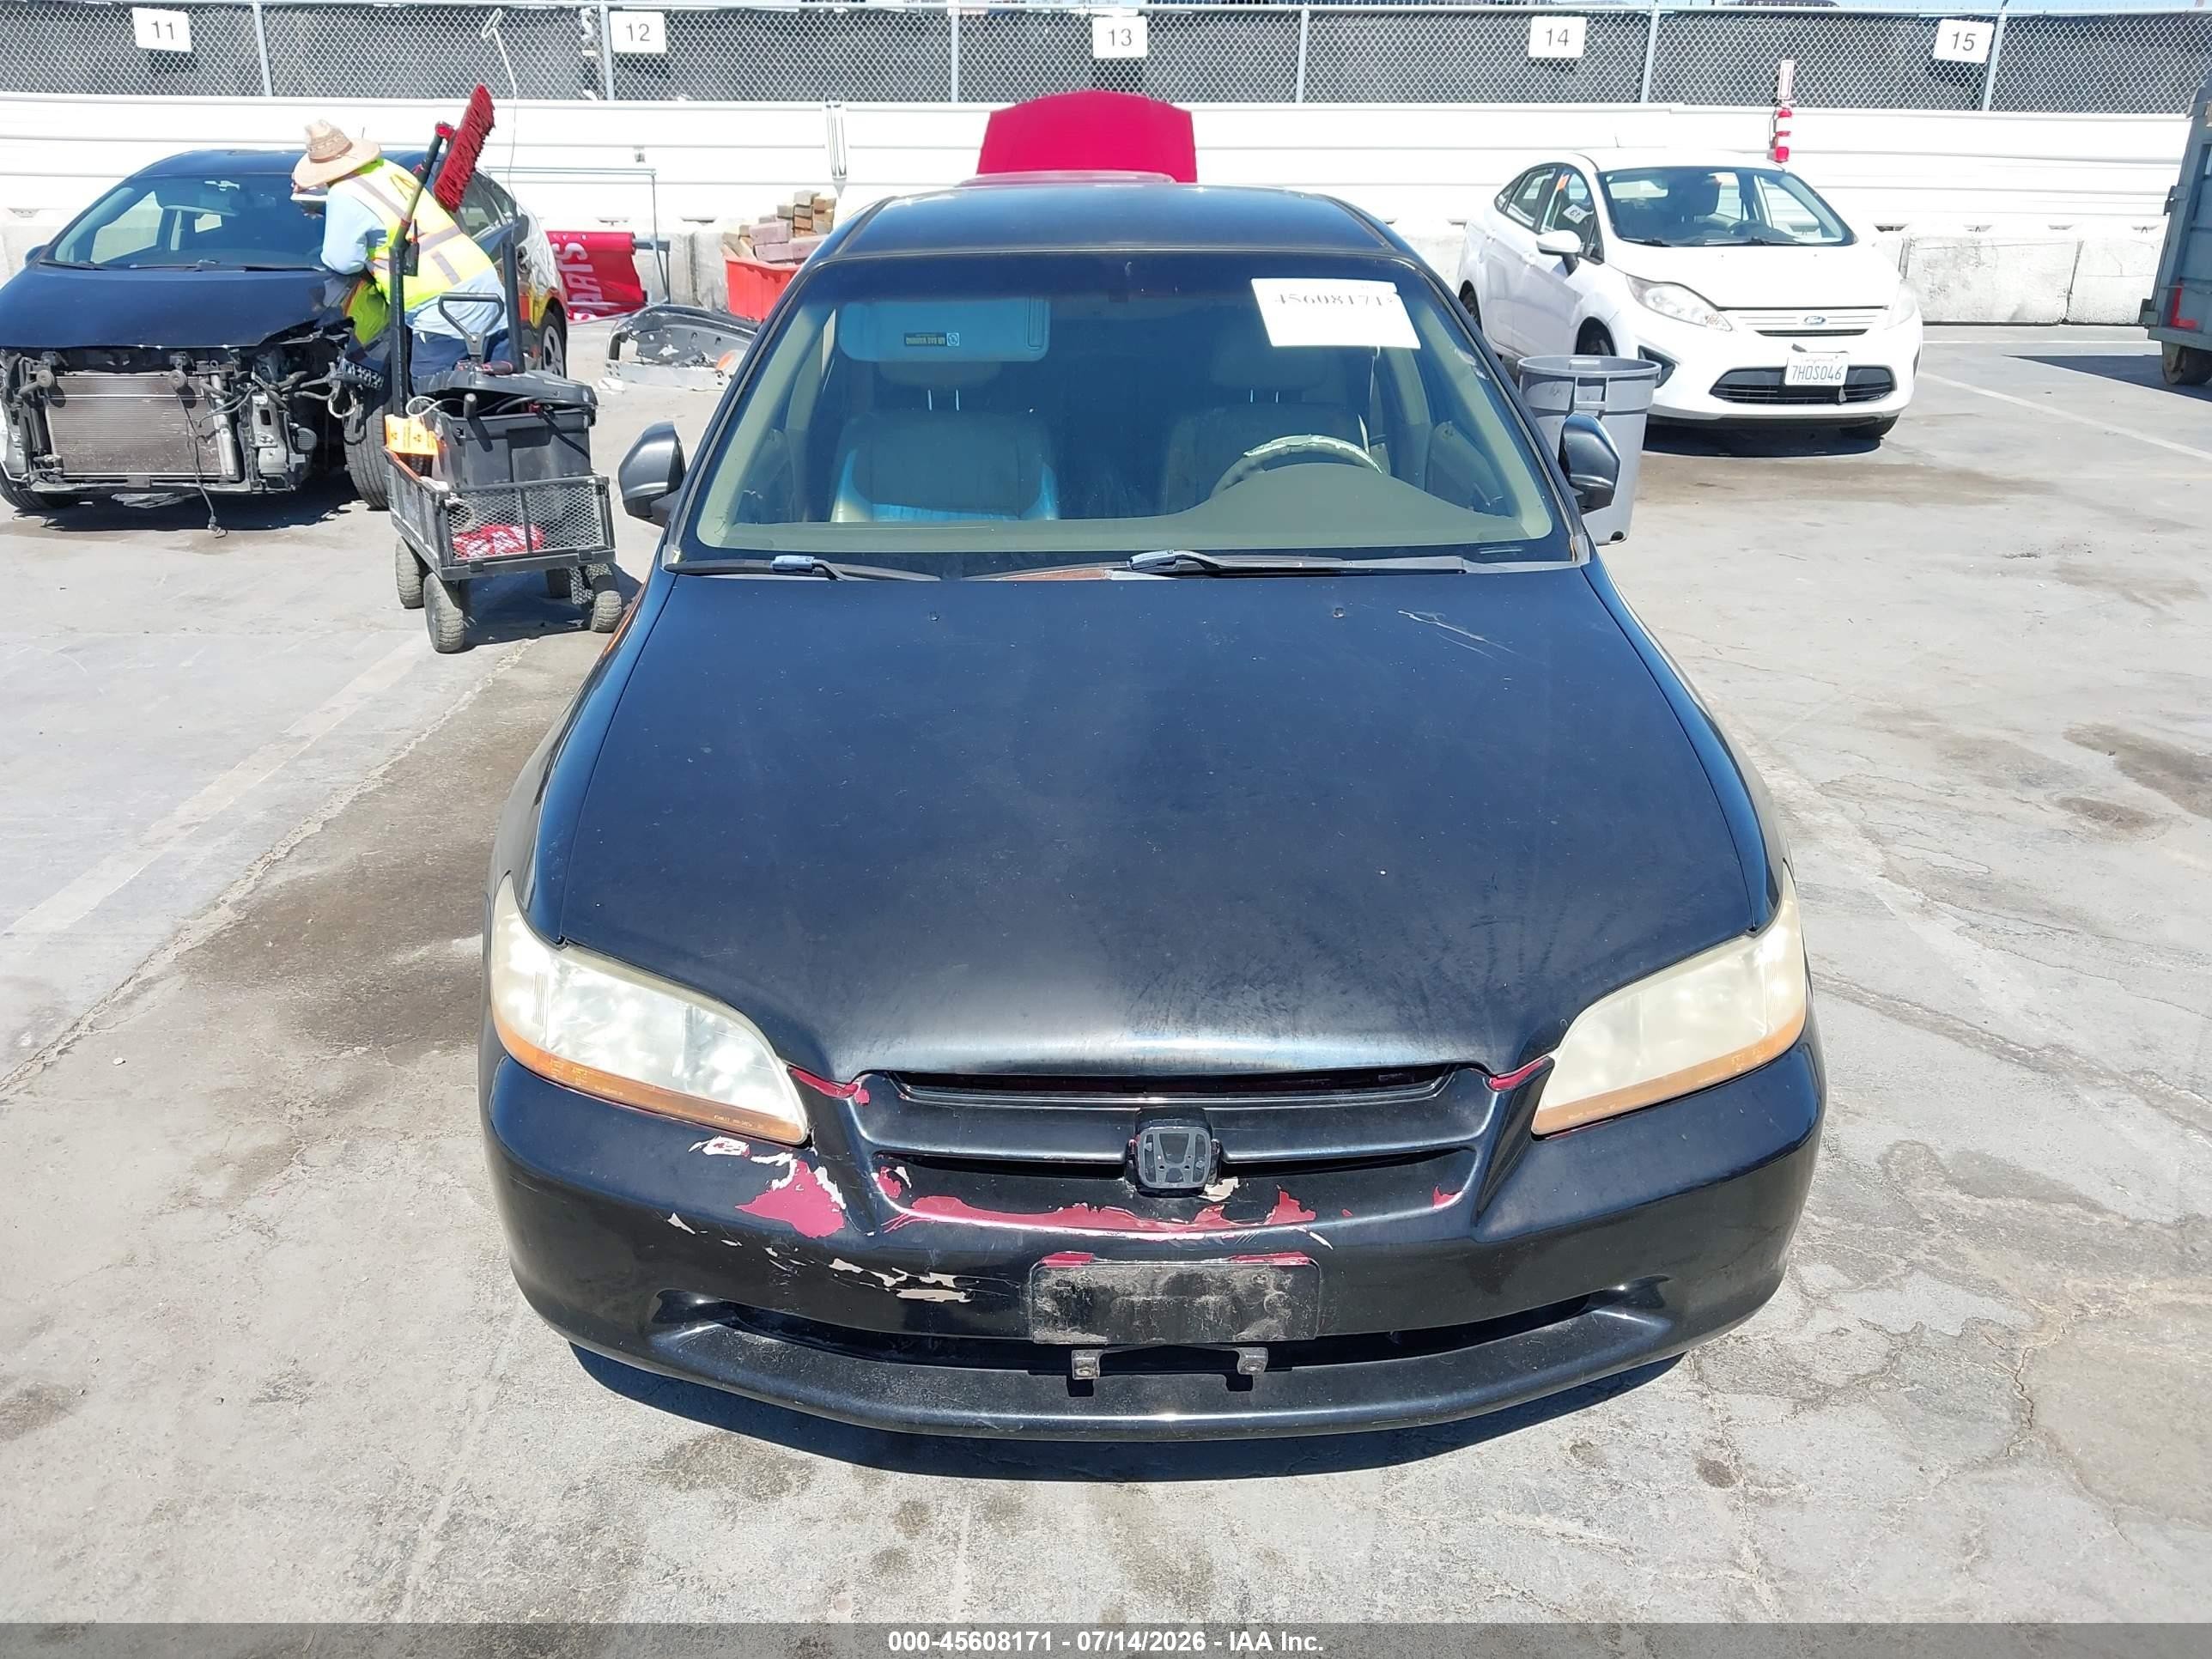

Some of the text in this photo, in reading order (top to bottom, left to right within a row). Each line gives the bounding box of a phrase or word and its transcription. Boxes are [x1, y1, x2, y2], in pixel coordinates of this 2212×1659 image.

[152, 21, 174, 40] 11
[627, 23, 649, 42] 12
[1109, 28, 1133, 47] 13
[1546, 27, 1569, 46] 14
[1952, 31, 1977, 52] 15
